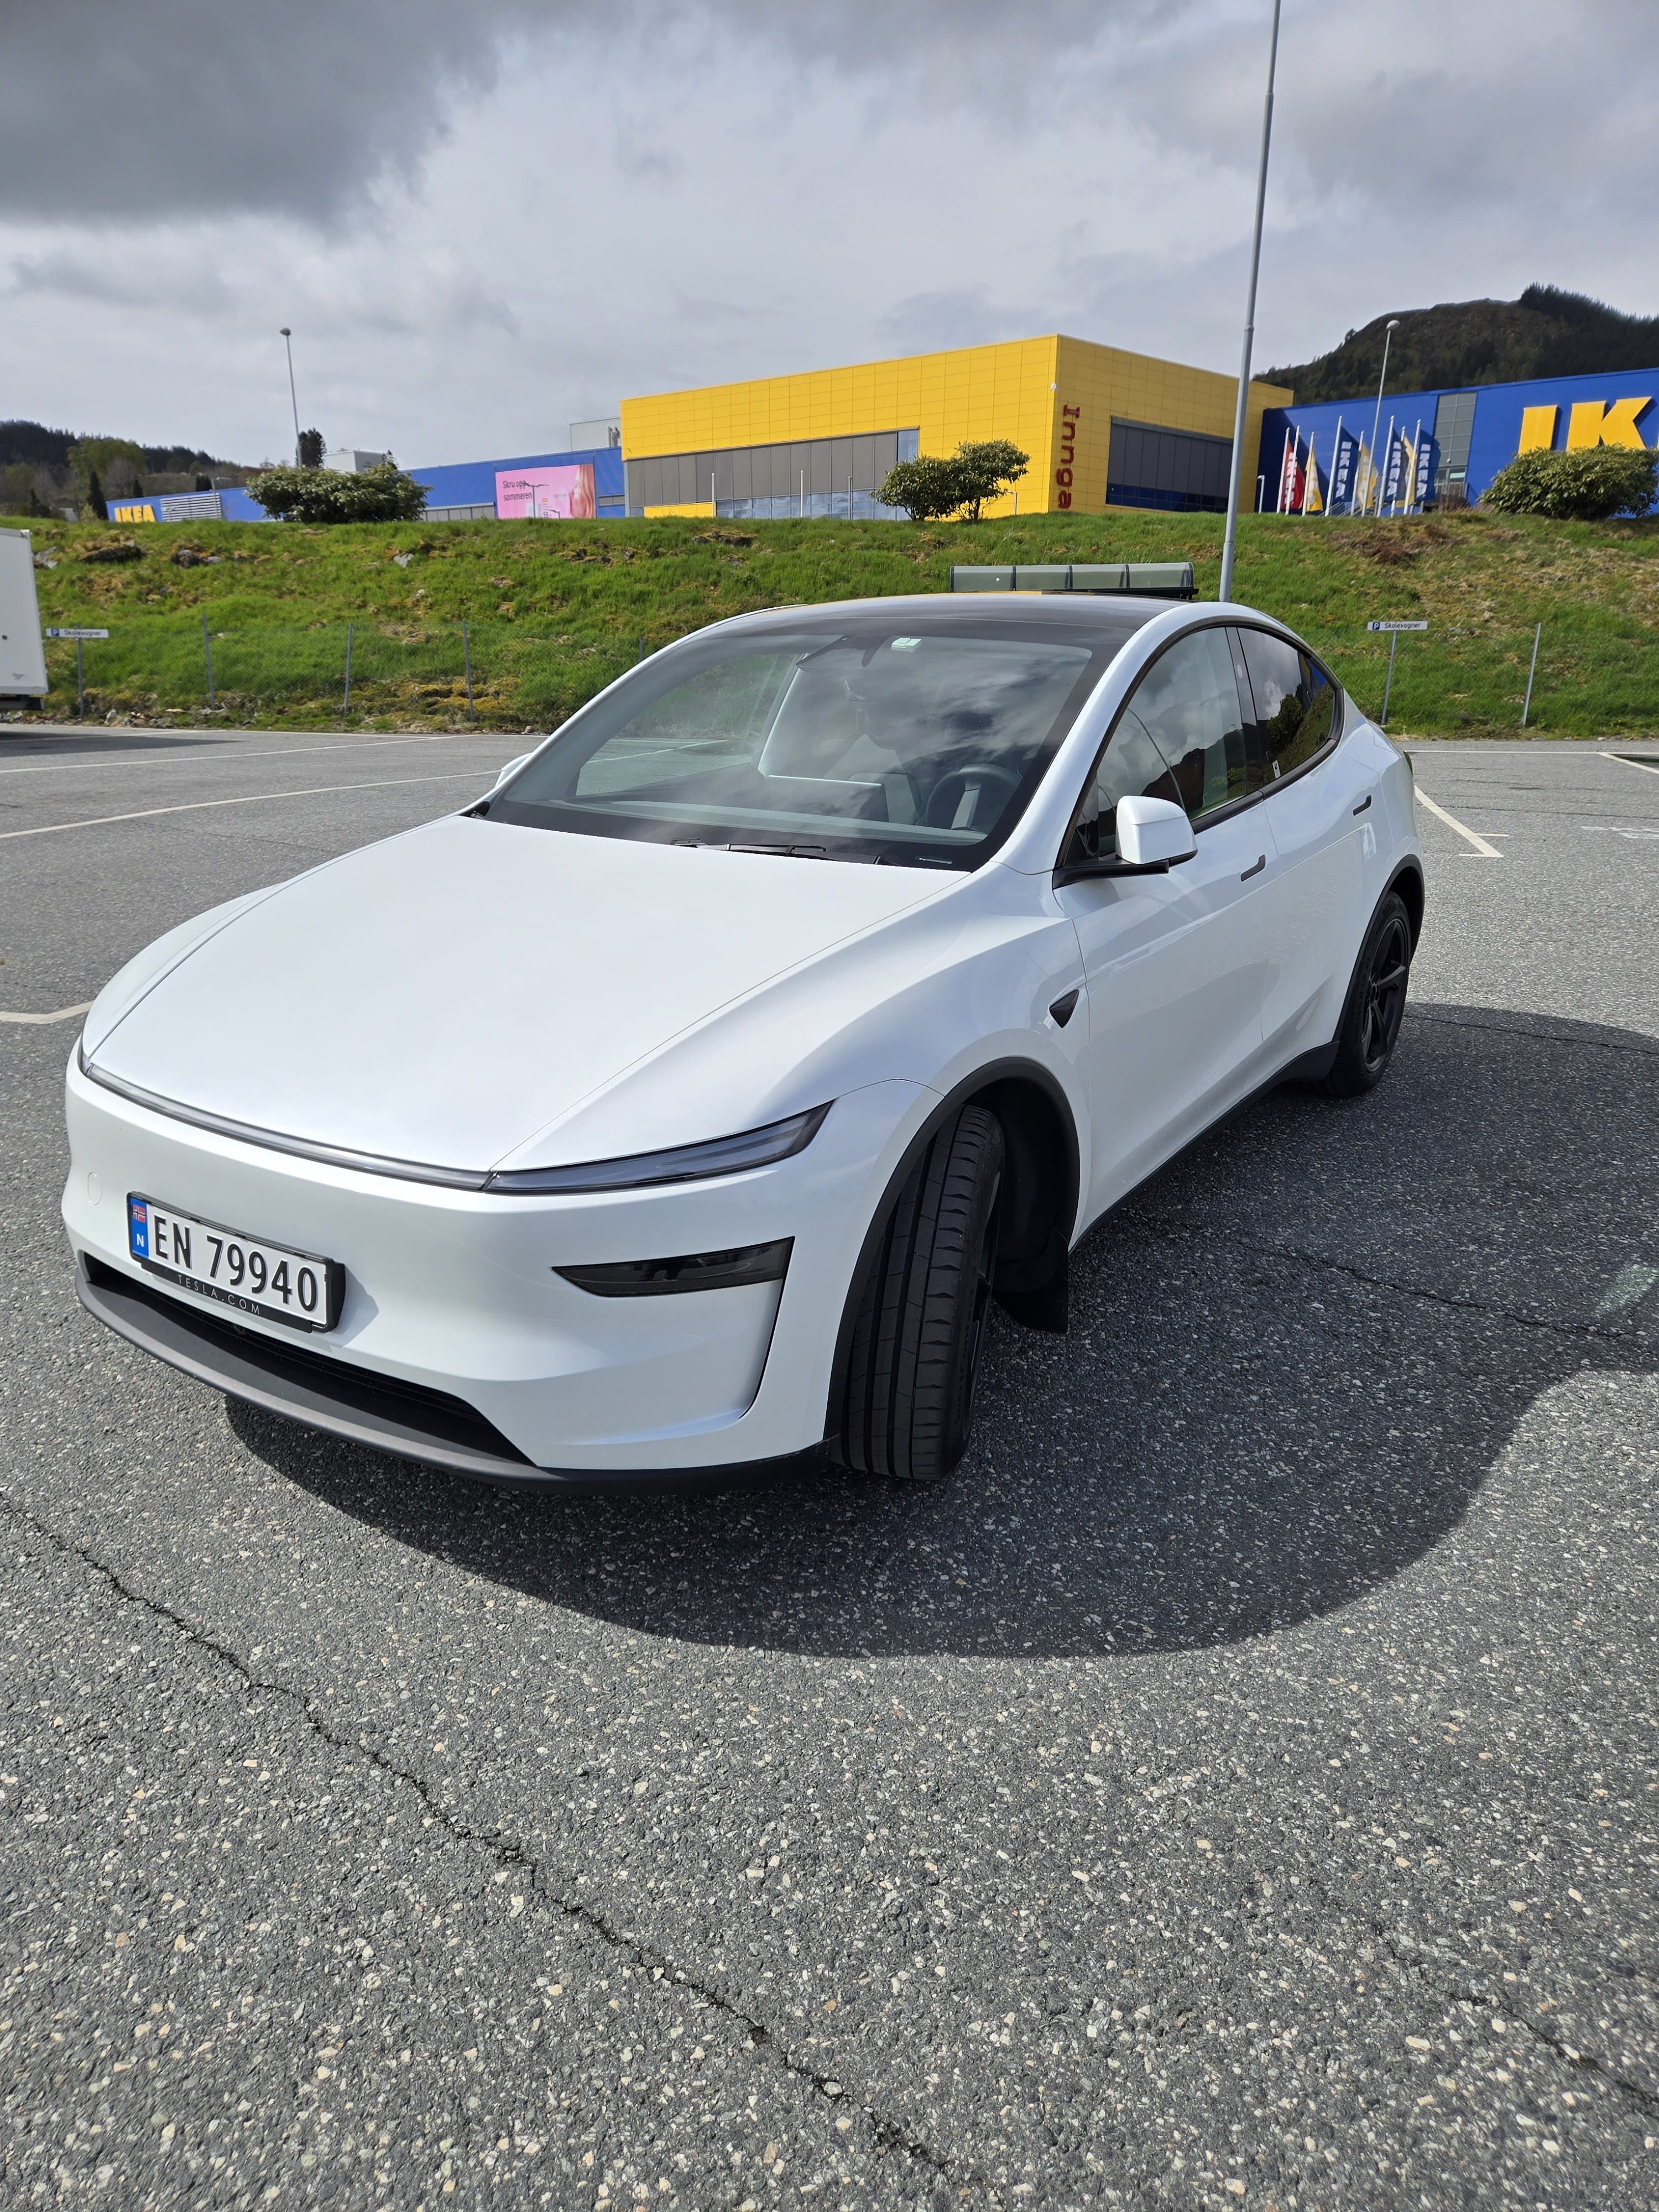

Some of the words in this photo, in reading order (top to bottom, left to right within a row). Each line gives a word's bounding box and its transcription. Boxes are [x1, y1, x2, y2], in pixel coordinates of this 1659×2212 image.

[1518, 396, 1659, 458] IK
[1335, 441, 1352, 499] IKEA
[1386, 442, 1402, 497] IKEA
[1416, 444, 1431, 498] IKEA
[114, 504, 155, 523] IKEA
[137, 1233, 144, 1248] N
[154, 1214, 192, 1270] EN
[206, 1234, 319, 1312] 79940
[178, 1275, 260, 1314] TESLA.COM
